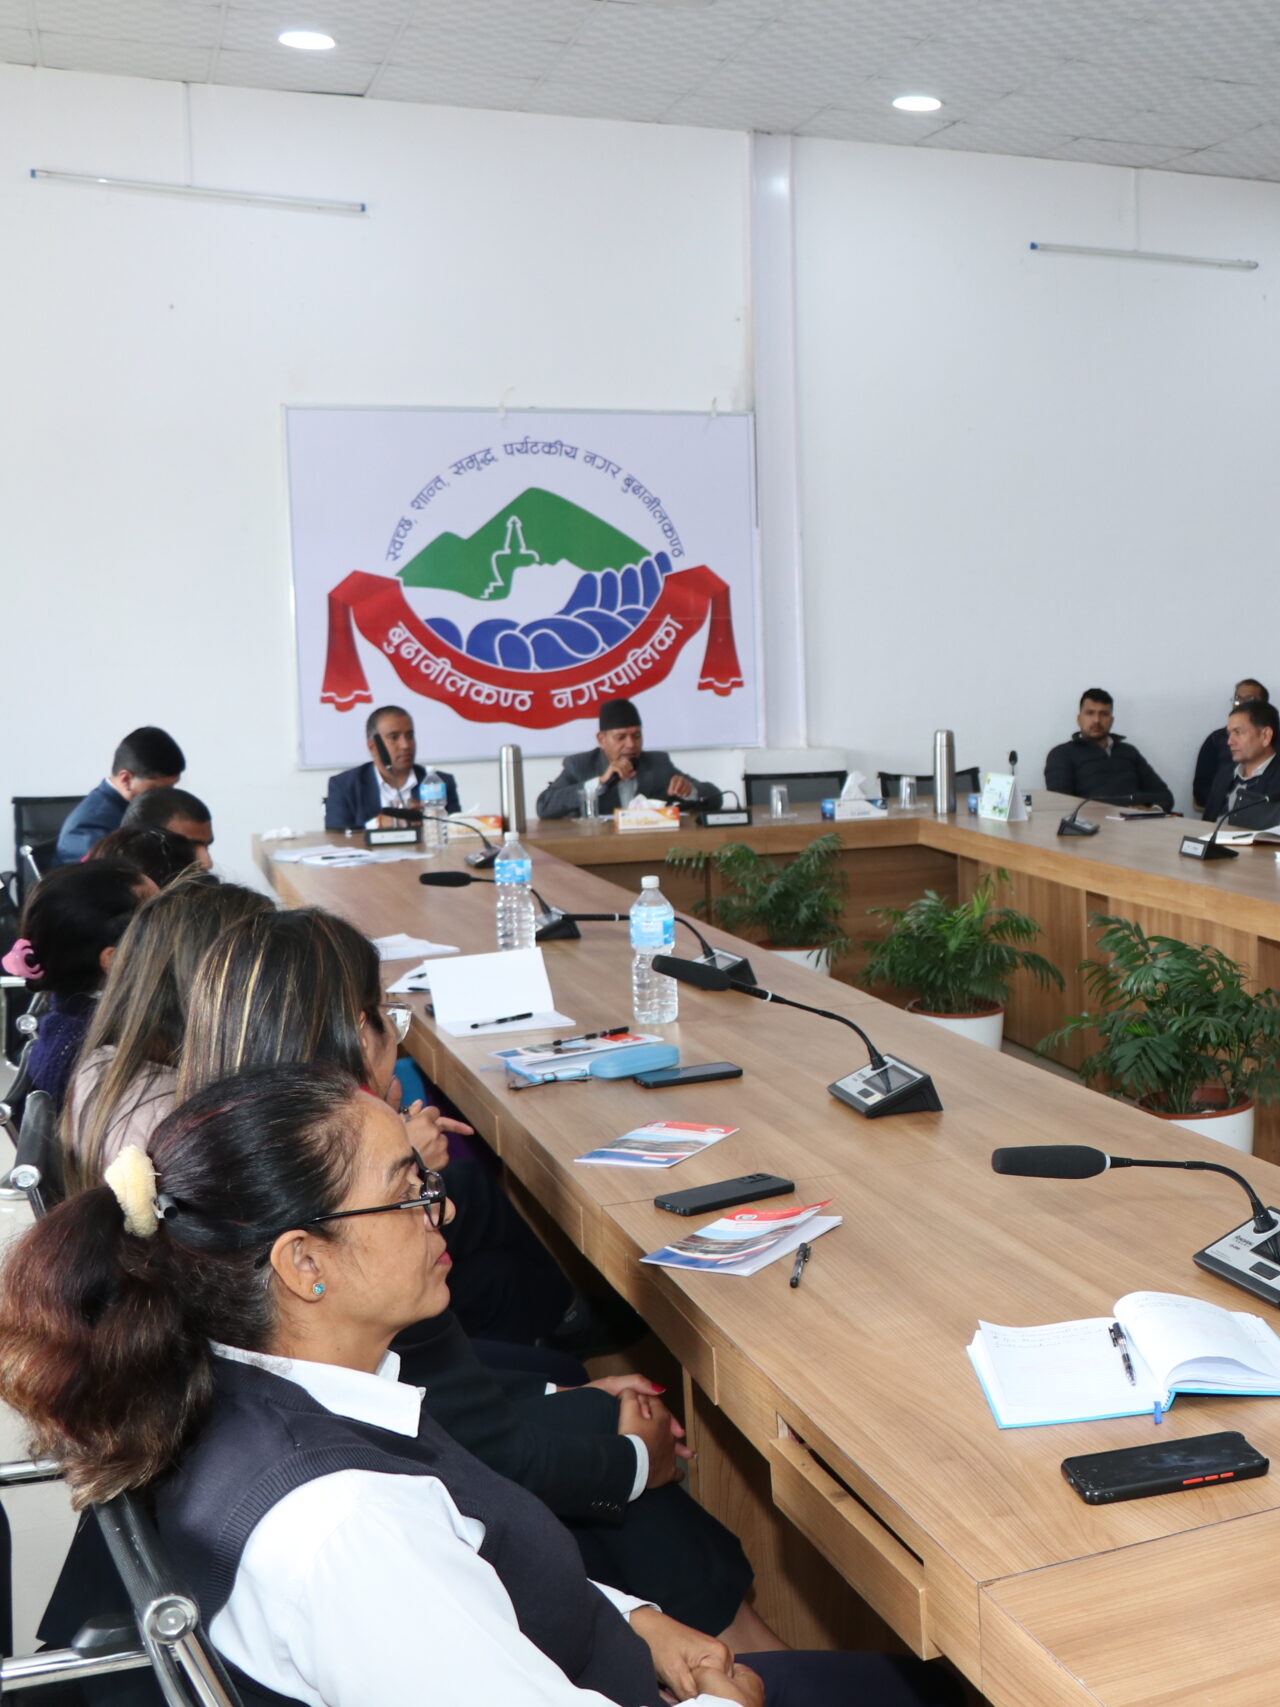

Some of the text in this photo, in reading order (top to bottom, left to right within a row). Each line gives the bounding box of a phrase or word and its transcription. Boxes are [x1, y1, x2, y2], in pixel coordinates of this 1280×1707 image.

[583, 450, 623, 478] नगर
[620, 472, 686, 559] बुढानीलकण्ठ
[383, 613, 684, 712] बुढानीलकण्ठ नगरपालिका
